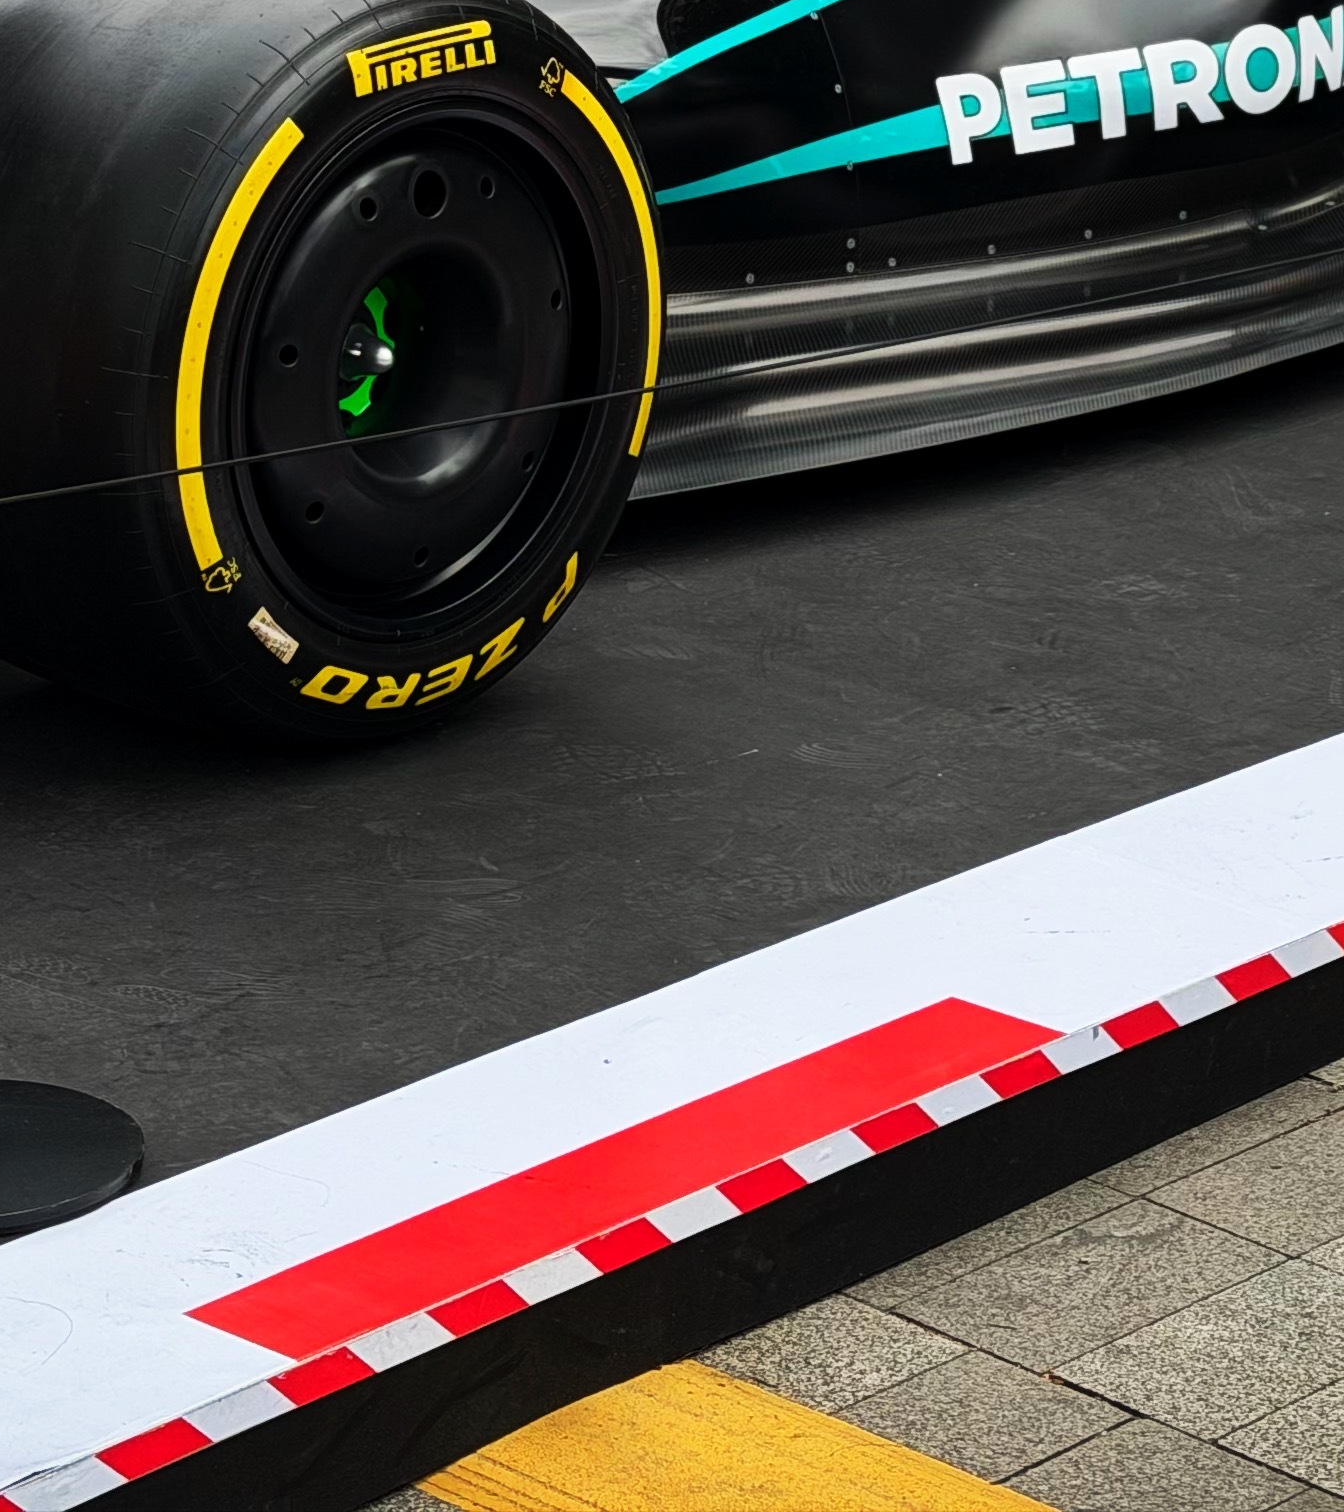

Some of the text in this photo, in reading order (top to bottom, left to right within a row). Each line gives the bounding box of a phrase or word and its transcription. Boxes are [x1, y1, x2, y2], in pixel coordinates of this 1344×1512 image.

[345, 19, 497, 99] PIRELLI
[542, 550, 578, 623] P
[300, 616, 526, 710] ZERO
